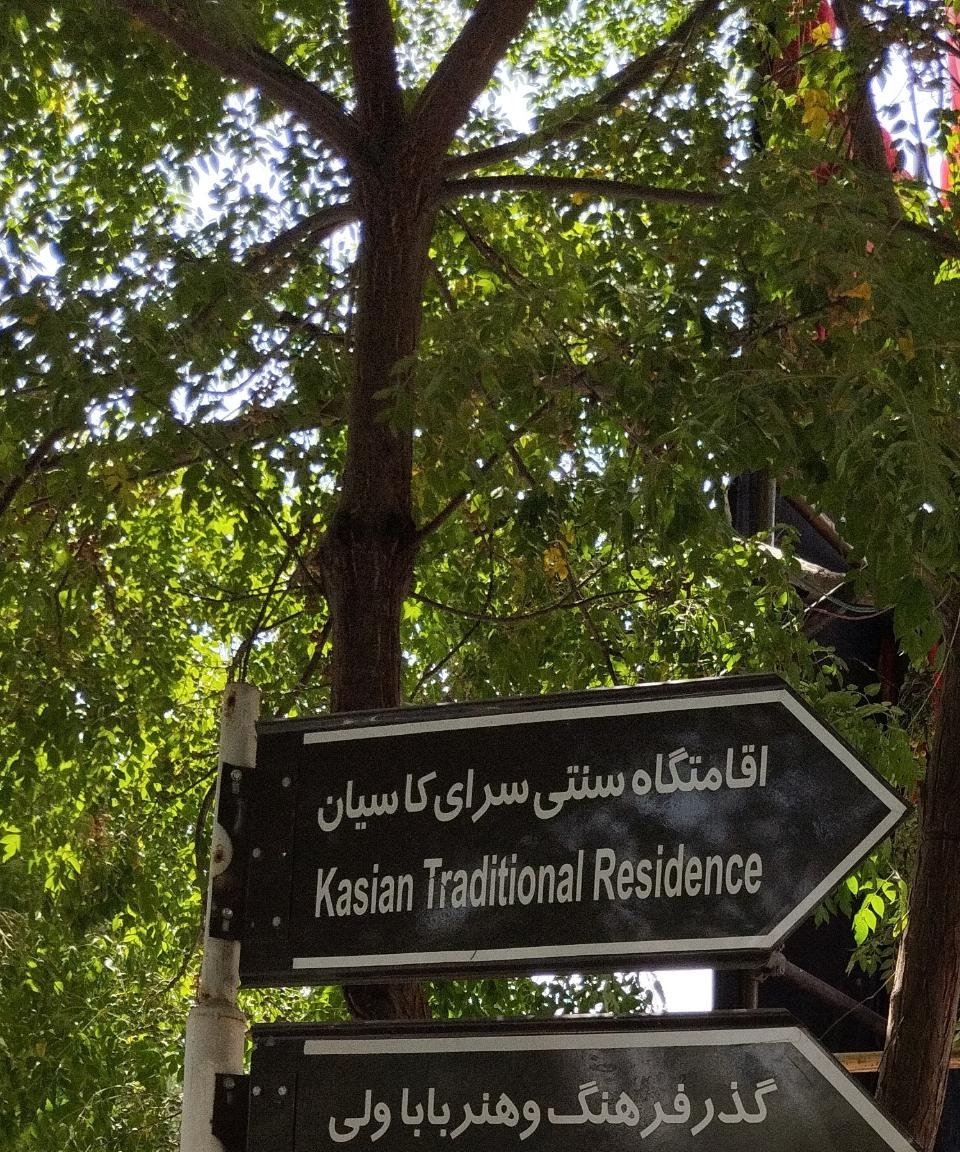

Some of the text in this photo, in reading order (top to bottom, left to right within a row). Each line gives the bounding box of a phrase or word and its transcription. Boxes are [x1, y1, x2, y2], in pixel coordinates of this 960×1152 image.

[433, 768, 529, 823] سرای
[533, 765, 625, 820] سنتی
[631, 744, 769, 796] اقامتگاه
[314, 843, 763, 918] Kasian Traditional Residence
[328, 1089, 392, 1143] ولی
[401, 1087, 451, 1137] بابا
[547, 1080, 691, 1139] فرهنگ
[690, 1078, 778, 1137] گذر
